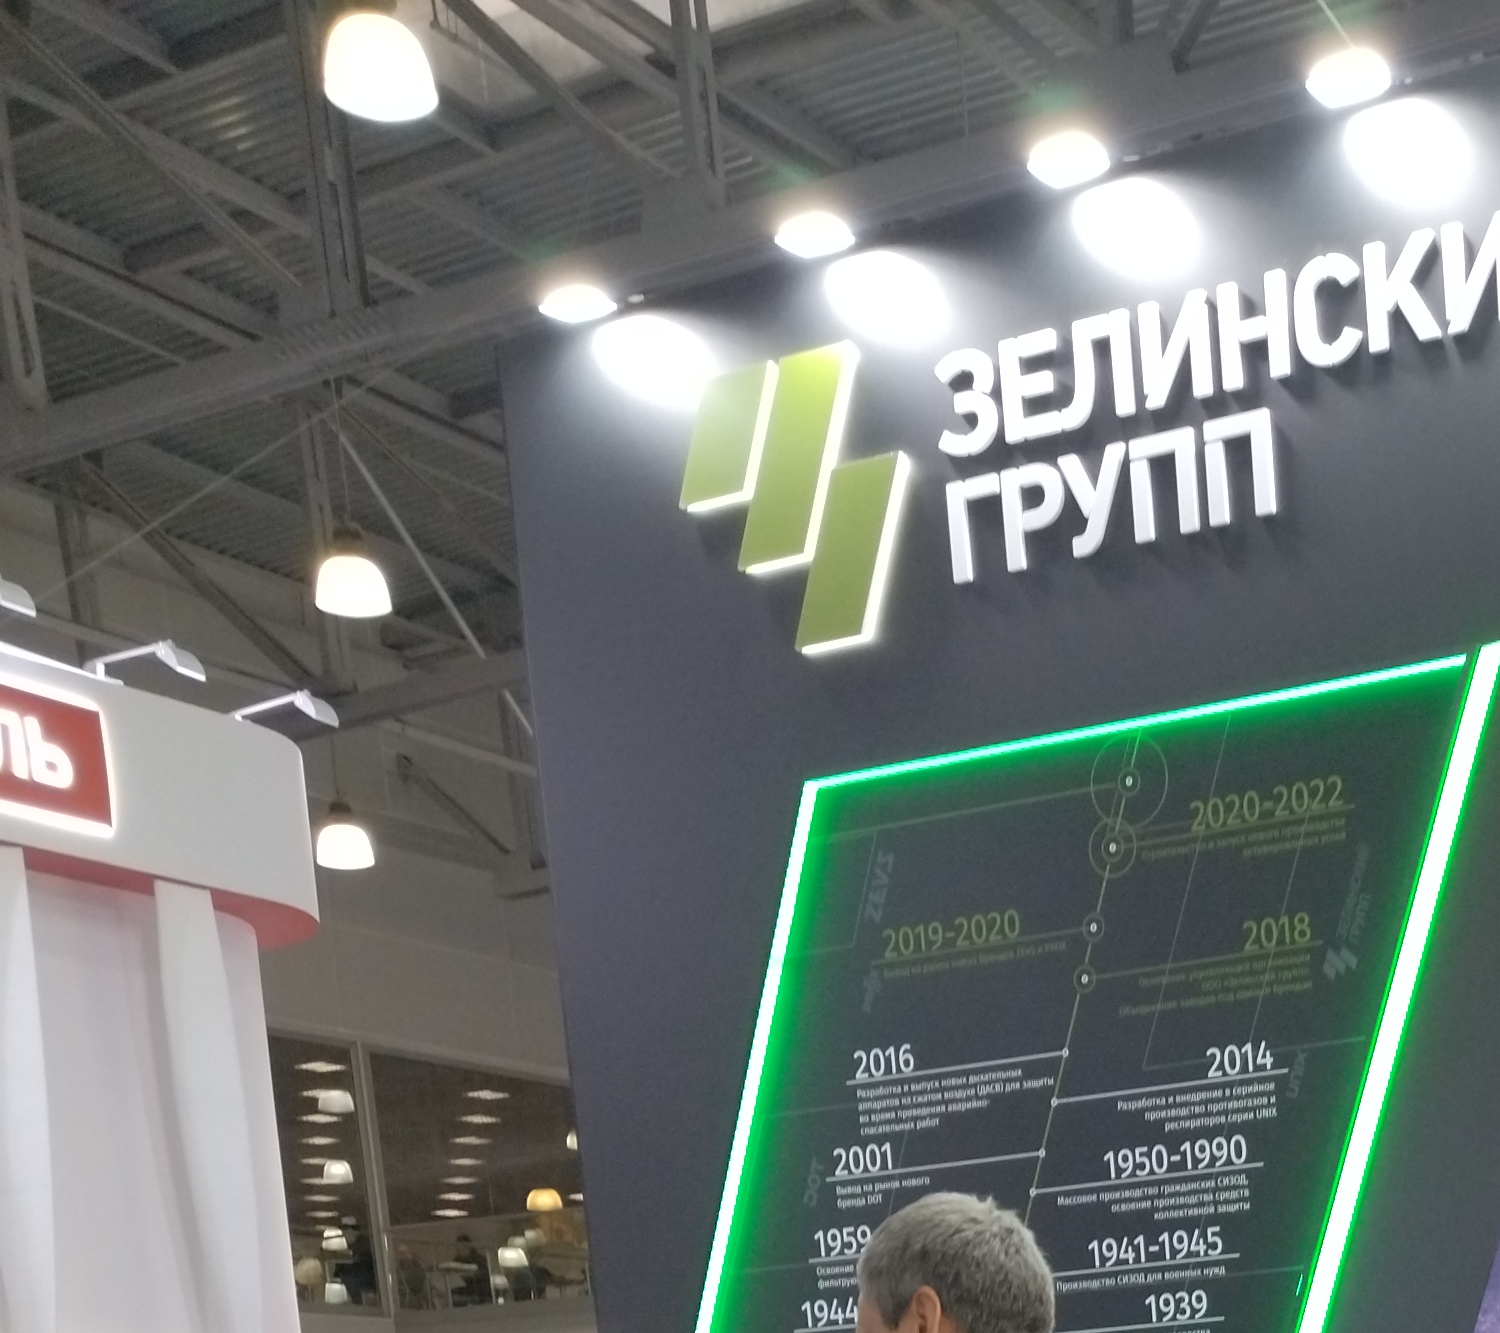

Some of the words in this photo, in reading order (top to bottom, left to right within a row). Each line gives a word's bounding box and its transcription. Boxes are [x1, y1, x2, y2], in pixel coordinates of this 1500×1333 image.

[945, 407, 1277, 584] ГРУПП
[1189, 775, 1344, 833] 2020-2022
[882, 908, 1020, 958] 2019-2020
[1242, 912, 1311, 951] 2018
[853, 1043, 914, 1079] 2016
[1206, 1040, 1273, 1078] 2014
[968, 1069, 1022, 1085] дыхательных
[1022, 1076, 1054, 1090] защиты
[1117, 1096, 1166, 1111] Разработка
[1175, 1088, 1223, 1104] внедрение
[1232, 1081, 1275, 1096] серийное
[1145, 1104, 1205, 1122] производство
[1207, 1096, 1268, 1114] противогазов
[916, 1117, 940, 1130] работ
[1164, 1113, 1226, 1132] респираторов
[833, 1141, 892, 1176] 2001
[1103, 1134, 1247, 1180] 1950-1990
[901, 1176, 930, 1187] нового
[1057, 1193, 1097, 1207] Массовое
[1099, 1186, 1158, 1202] производство
[1160, 1180, 1216, 1196] гражданских
[867, 1193, 882, 1205] DOT
[1111, 1200, 1151, 1213] освоение
[1153, 1193, 1213, 1209] производства
[1215, 1187, 1250, 1202] средств
[1154, 1205, 1215, 1221] коллективной
[1217, 1201, 1251, 1214] защиты
[814, 1225, 871, 1258] 1959
[1088, 1225, 1223, 1268] 1941-1945
[817, 1276, 857, 1290] фильтрую
[1056, 1278, 1116, 1293] Производство
[1117, 1272, 1145, 1285] СИЗОД
[1147, 1272, 1162, 1283] для
[1164, 1268, 1200, 1281] военных
[1203, 1265, 1226, 1277] нужд
[801, 1296, 858, 1328] 1944
[1145, 1289, 1208, 1323] 1939
